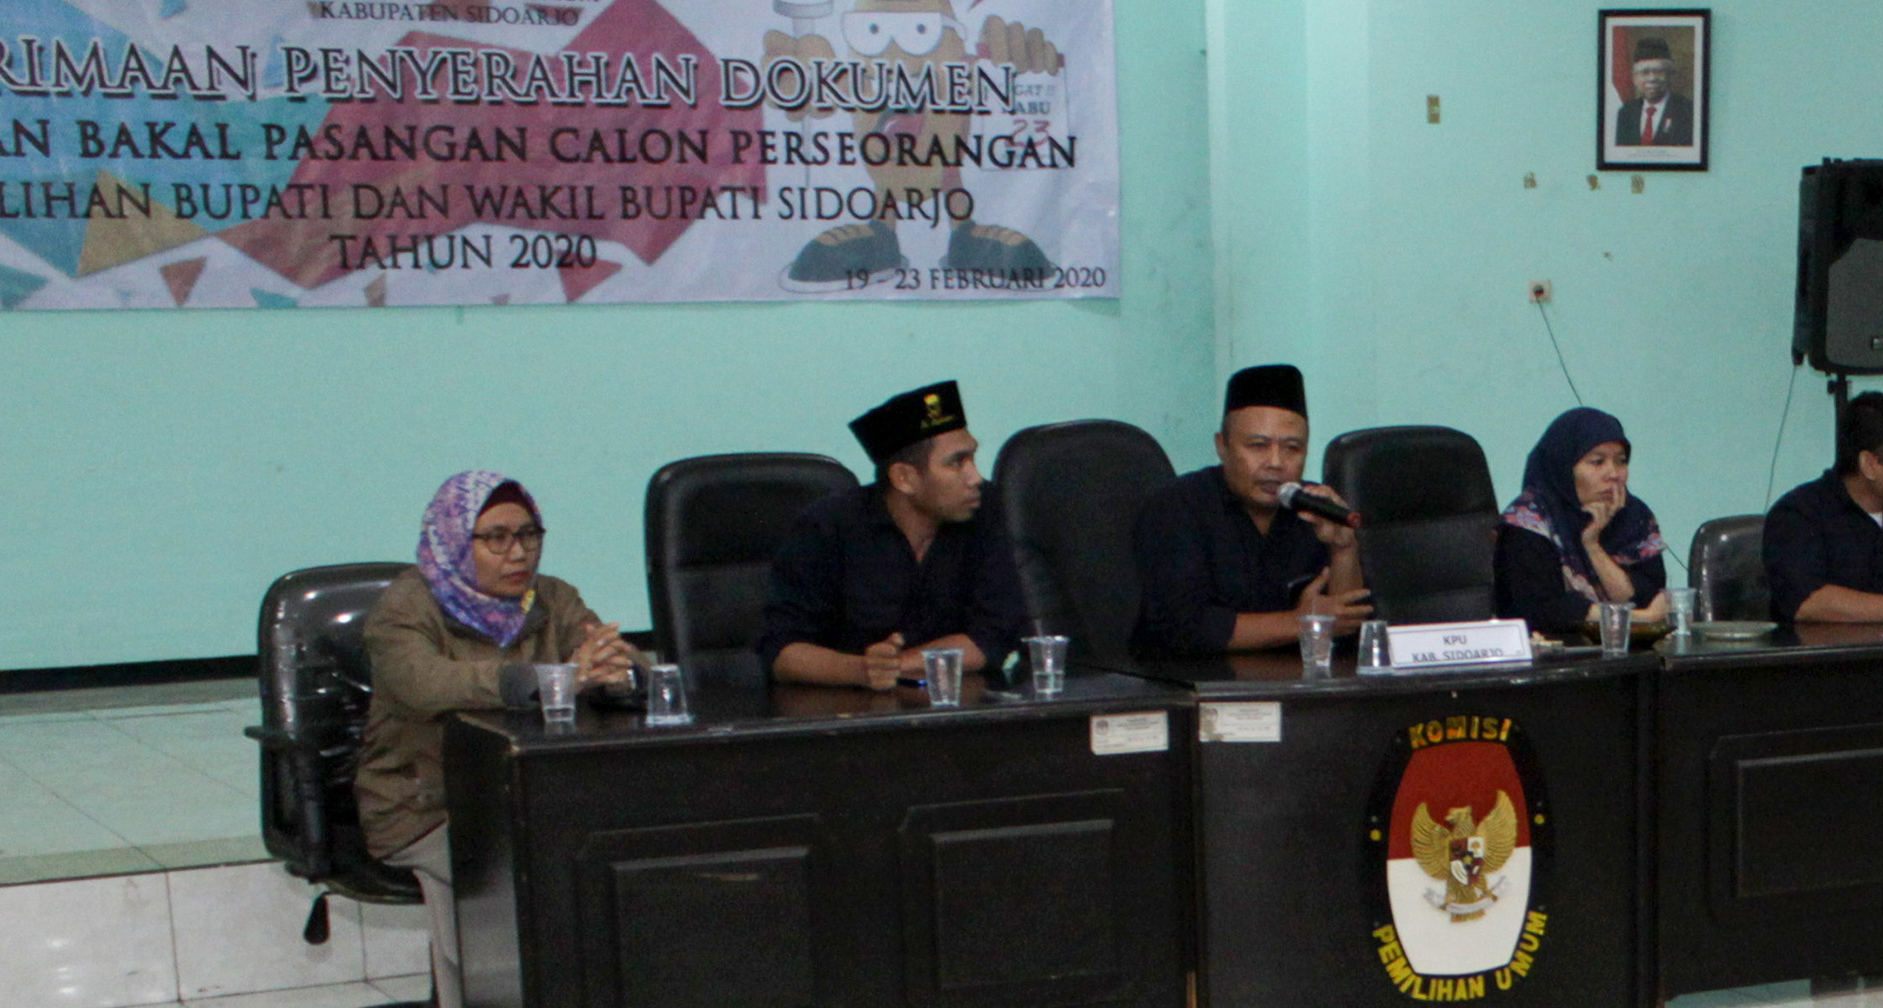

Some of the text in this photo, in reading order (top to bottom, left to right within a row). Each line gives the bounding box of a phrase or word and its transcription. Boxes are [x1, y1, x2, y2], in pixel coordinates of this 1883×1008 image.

[319, 1, 580, 26] KABUPATEN SIDOARJO
[280, 45, 698, 107] PENYERAHAN
[720, 57, 1017, 114] DOKUMEN
[76, 119, 241, 160] BAKAL
[261, 122, 528, 163] PASANGAN
[548, 127, 709, 164] CALON
[730, 129, 1078, 169] PERSEORANGAN
[170, 183, 333, 220] BUPATI
[352, 183, 449, 220] DAN
[463, 184, 605, 220] WAKIL
[619, 184, 761, 221] BUPATI
[777, 185, 975, 229] SIDOARJO
[329, 234, 597, 270] TAHUN 2020
[844, 270, 869, 290] 19
[894, 268, 921, 290] 23
[929, 267, 1044, 291] FEBRUARI
[1053, 267, 1107, 289] 2020
[1442, 634, 1468, 646] KPU
[1408, 715, 1512, 749] KOMISI
[1372, 910, 1548, 1001] PEMILIHAN UMUM
